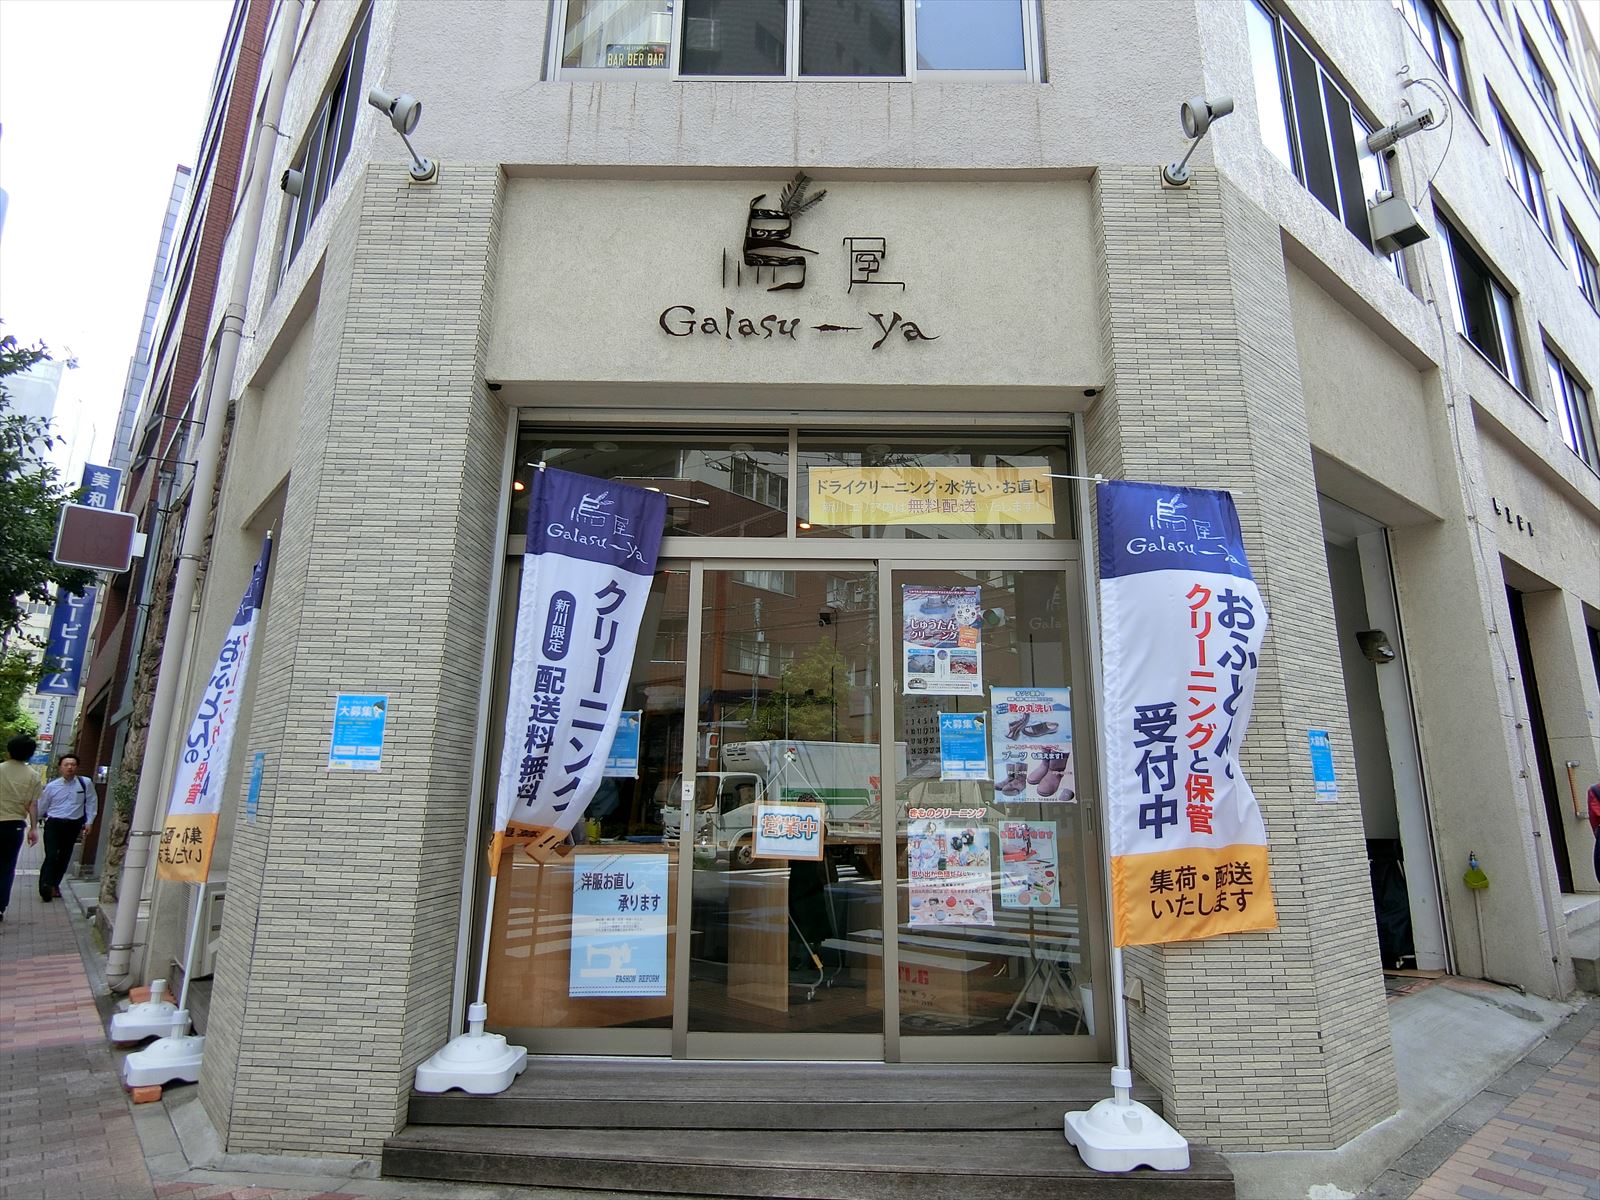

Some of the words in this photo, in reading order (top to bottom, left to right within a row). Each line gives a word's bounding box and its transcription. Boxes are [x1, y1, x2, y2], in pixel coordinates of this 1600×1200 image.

[607, 53, 624, 66] BAR
[627, 53, 644, 66] BER
[647, 53, 664, 66] BAR
[88, 472, 112, 508] 美和
[547, 598, 572, 654] 新川限定
[910, 619, 957, 630] じゅうたん
[1008, 703, 1053, 713] 靴の丸洗い
[1184, 582, 1217, 836] クリーニングと保管
[942, 719, 973, 729] 大募集
[516, 664, 567, 808] 配送料無料
[1132, 700, 1178, 840] 受付中
[909, 807, 987, 819] きものクリーニング
[761, 813, 818, 840] 営業中
[581, 872, 635, 891] 洋服お直し
[1149, 862, 1255, 896] 集荷・配送
[618, 894, 661, 912] 承ります
[1150, 887, 1254, 921] いたします
[639, 974, 660, 983] REFORM
